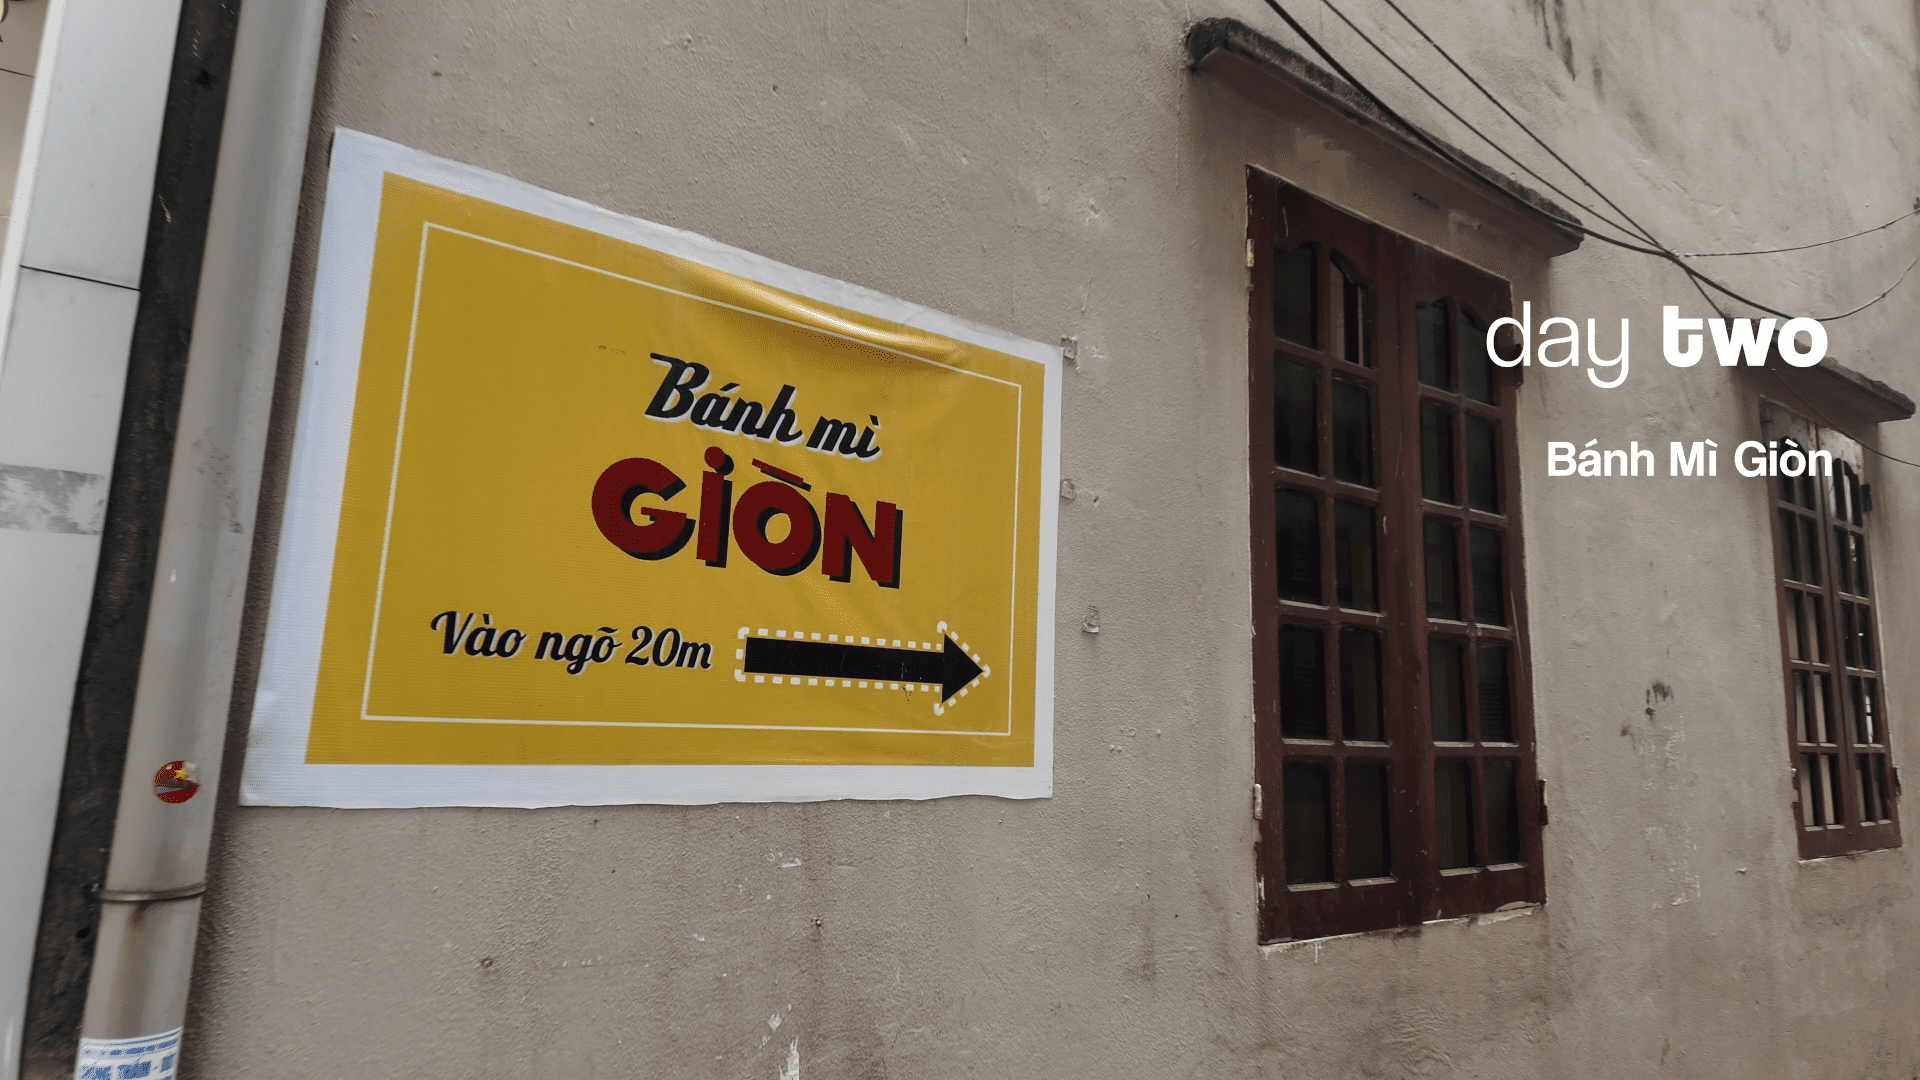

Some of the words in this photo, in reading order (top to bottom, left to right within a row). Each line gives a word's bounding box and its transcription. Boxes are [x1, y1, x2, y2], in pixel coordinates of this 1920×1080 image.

[644, 352, 803, 447] Bánh
[805, 414, 882, 463] mì
[430, 610, 527, 659] Vào
[534, 626, 623, 676] ngõ
[625, 625, 713, 671] 20m
